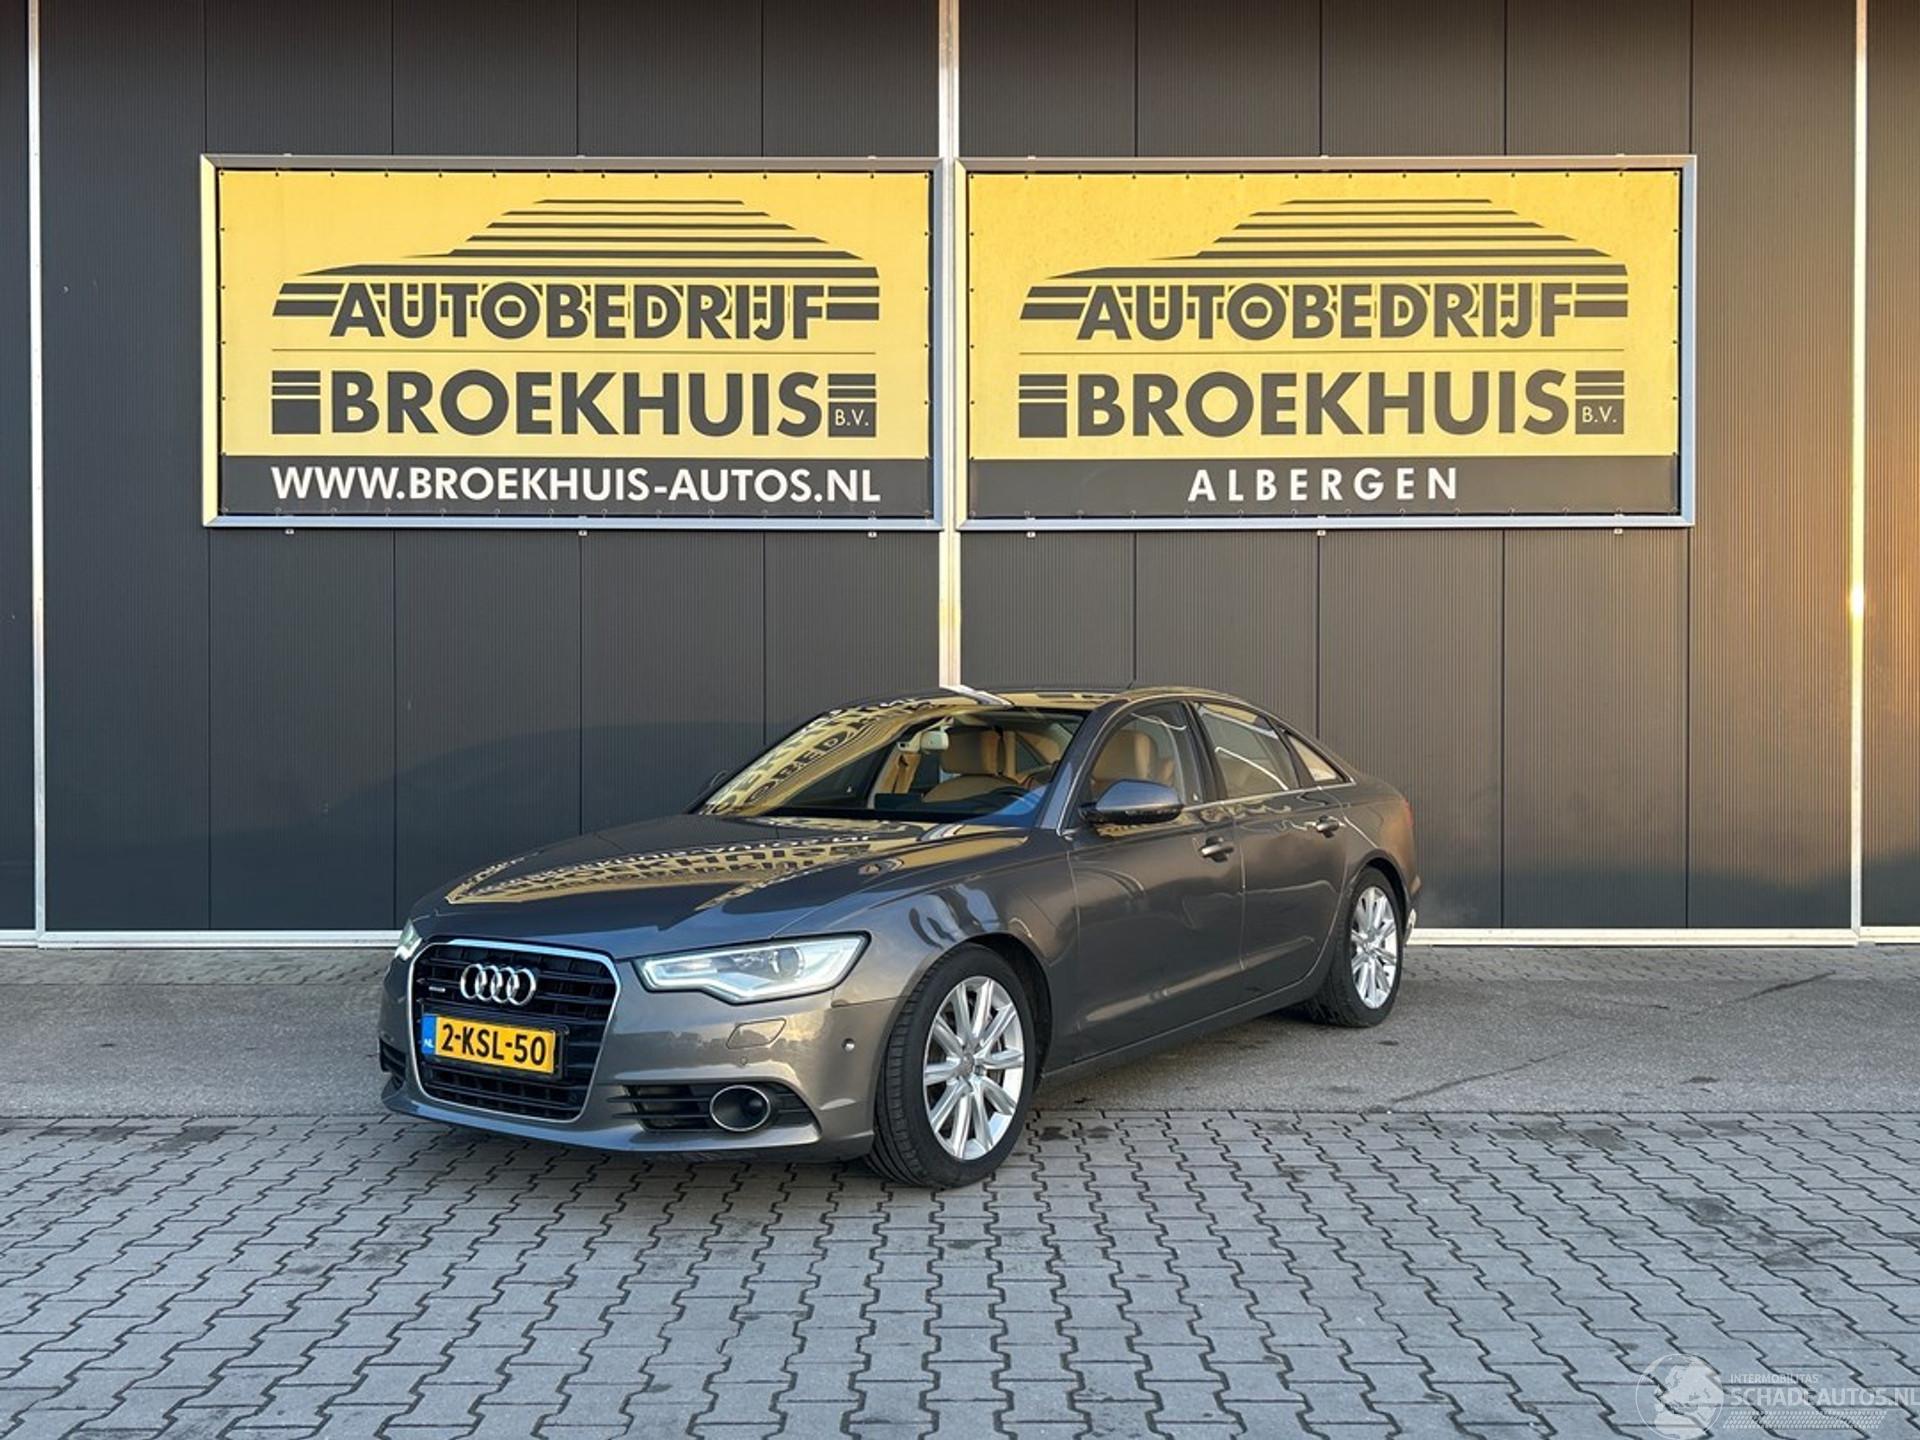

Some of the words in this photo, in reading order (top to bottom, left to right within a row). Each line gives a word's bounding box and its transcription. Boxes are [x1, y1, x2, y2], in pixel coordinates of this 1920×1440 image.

[330, 281, 827, 340] AUTOBEDRIJF
[1076, 282, 1573, 341] AUTOBEDRIJF
[330, 369, 822, 437] BROEKHUIS
[834, 408, 869, 427] B.V.
[1077, 369, 1569, 437] BROEKHUIS
[1582, 405, 1618, 424] B.V.
[271, 466, 880, 503] WWW.BROEKHUIS-AUTOS.NL
[1188, 466, 1458, 502] ALBERGEN
[441, 1023, 546, 1066] 2-KSL-50
